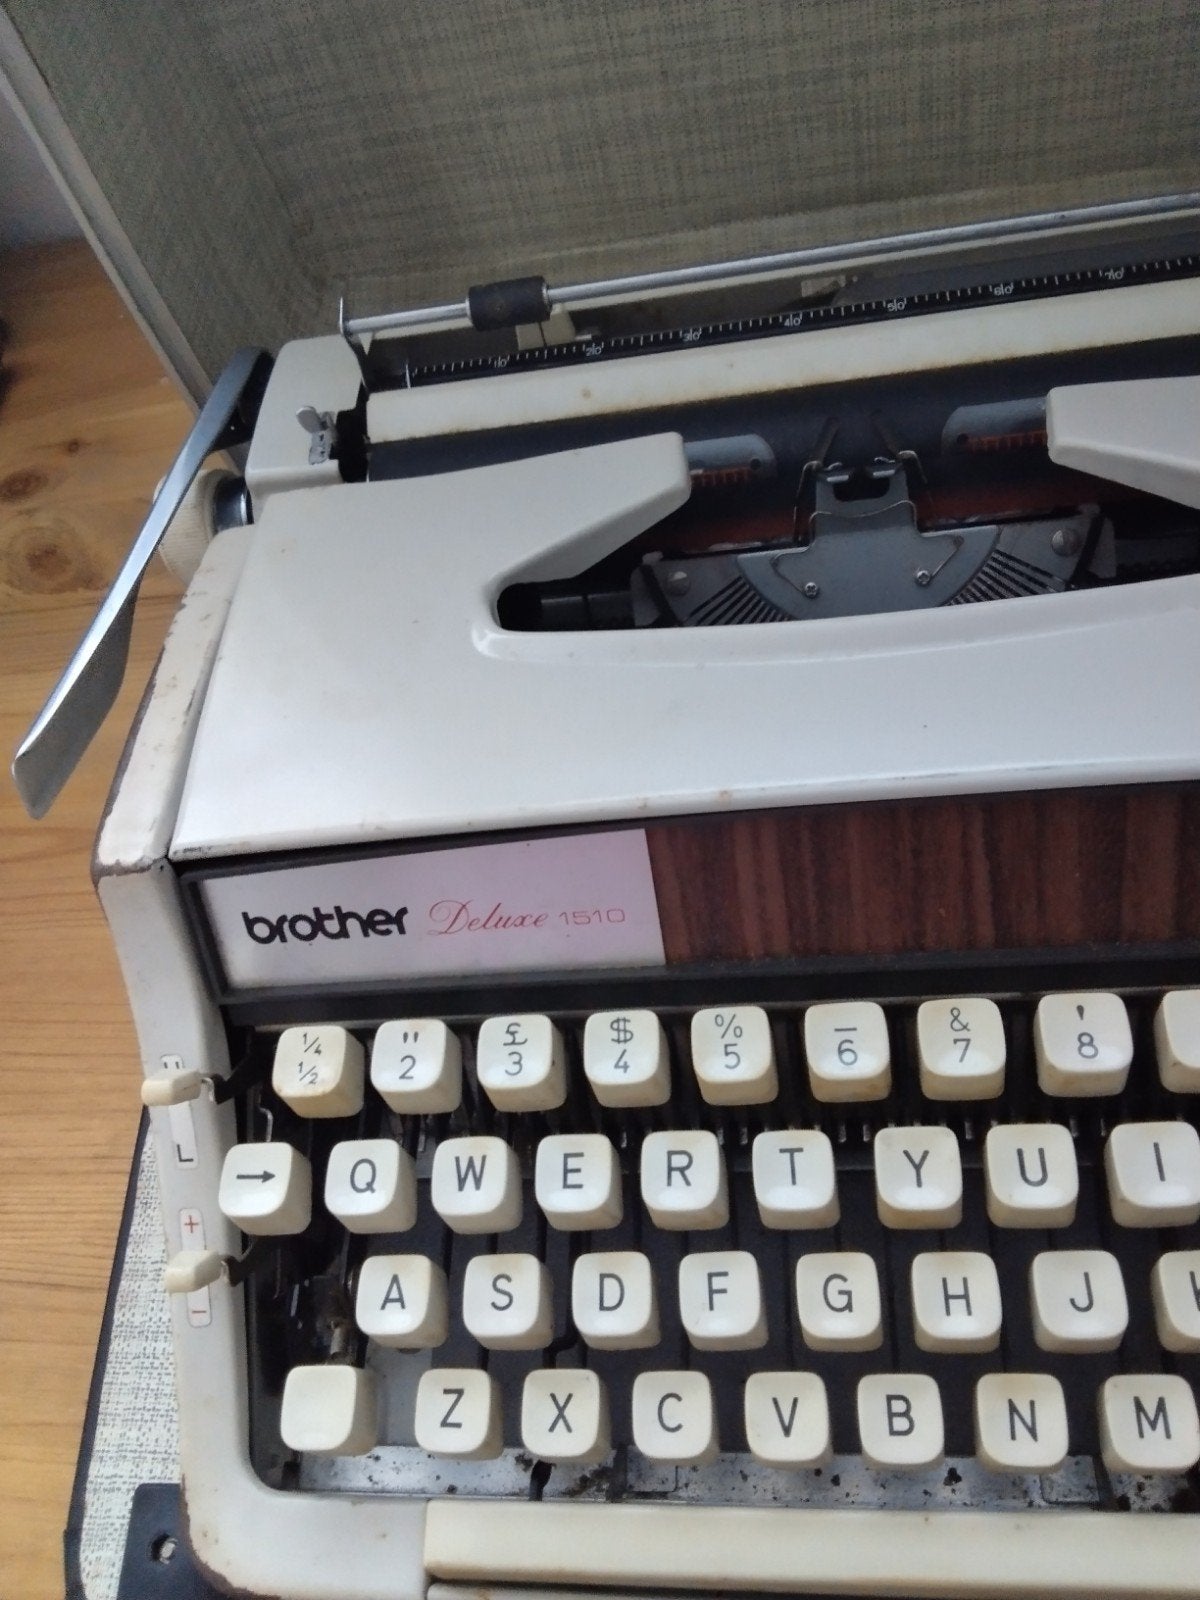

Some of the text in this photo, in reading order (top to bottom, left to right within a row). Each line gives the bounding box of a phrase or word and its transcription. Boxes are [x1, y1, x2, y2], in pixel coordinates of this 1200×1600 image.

[783, 313, 802, 328] 40
[886, 298, 906, 312] 50
[241, 899, 626, 945] brother Deluxe 1510
[502, 1022, 528, 1047] £
[609, 1016, 634, 1045] $
[714, 1013, 743, 1039] %
[949, 1006, 971, 1032] &
[505, 1050, 523, 1076] 3
[613, 1048, 630, 1074] 4
[723, 1042, 741, 1069] 5
[837, 1038, 858, 1066] 6
[952, 1037, 972, 1063] 7
[1076, 1031, 1099, 1059] 8
[398, 1054, 417, 1080] 2
[349, 1158, 377, 1194] Q
[454, 1154, 487, 1192] W
[562, 1151, 585, 1190] E
[666, 1149, 694, 1187] R
[778, 1147, 804, 1186] T
[902, 1149, 930, 1188] Y
[1016, 1147, 1049, 1187] U
[380, 1273, 406, 1311] A
[490, 1273, 514, 1312] S
[598, 1272, 625, 1312] D
[706, 1270, 729, 1312] F
[822, 1273, 853, 1313] G
[941, 1276, 972, 1317] H
[1069, 1271, 1094, 1313] J
[440, 1387, 465, 1429] Z
[548, 1392, 574, 1434] X
[657, 1392, 683, 1433] C
[771, 1396, 799, 1438] V
[885, 1393, 915, 1437] B
[1007, 1398, 1038, 1442] N
[1132, 1395, 1172, 1440] M
